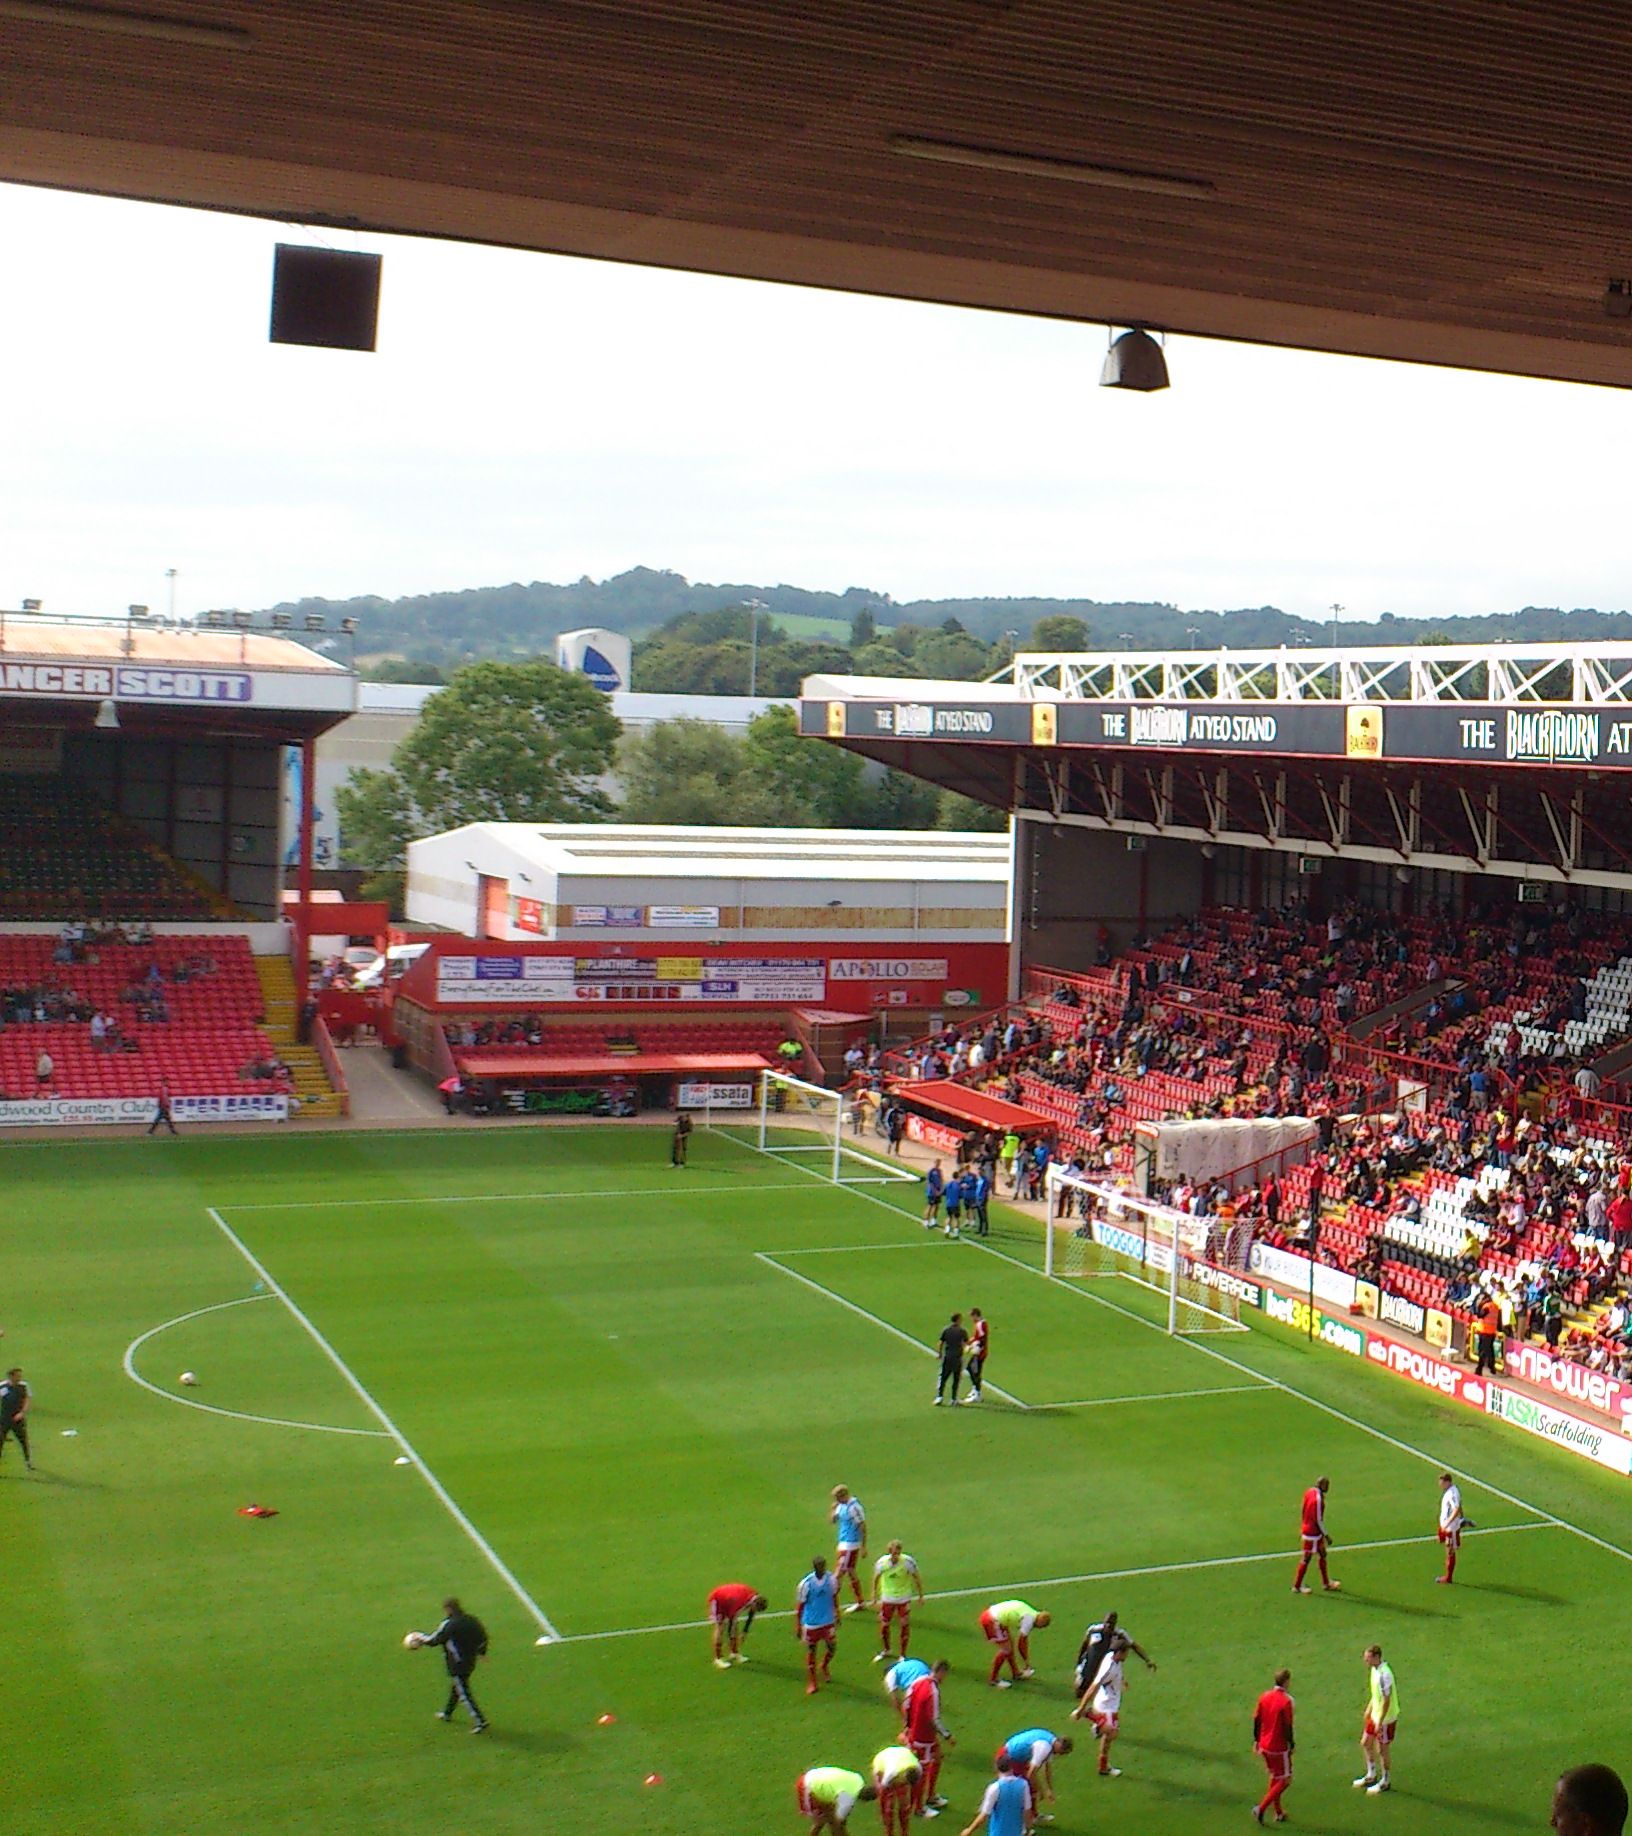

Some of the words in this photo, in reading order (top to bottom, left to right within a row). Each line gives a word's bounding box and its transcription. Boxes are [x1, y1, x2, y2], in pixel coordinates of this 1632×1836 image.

[0, 664, 111, 693] NCER
[119, 671, 246, 698] SCOTT
[877, 710, 893, 729] THE
[963, 711, 993, 733] STAND
[1102, 714, 1125, 736] THE
[1190, 715, 1231, 741] ATYEO
[1232, 716, 1277, 742] STAND
[1459, 720, 1496, 749] THE
[1506, 710, 1599, 763] BLACKTHORN
[56, 1103, 114, 1115] Country
[121, 1101, 156, 1113] Club
[1192, 1262, 1260, 1306] POWERADE
[1266, 1287, 1362, 1356] bet365.com
[1387, 1344, 1462, 1396] npower
[1519, 1347, 1620, 1410] npower
[1539, 1414, 1603, 1456] Scaffolding
